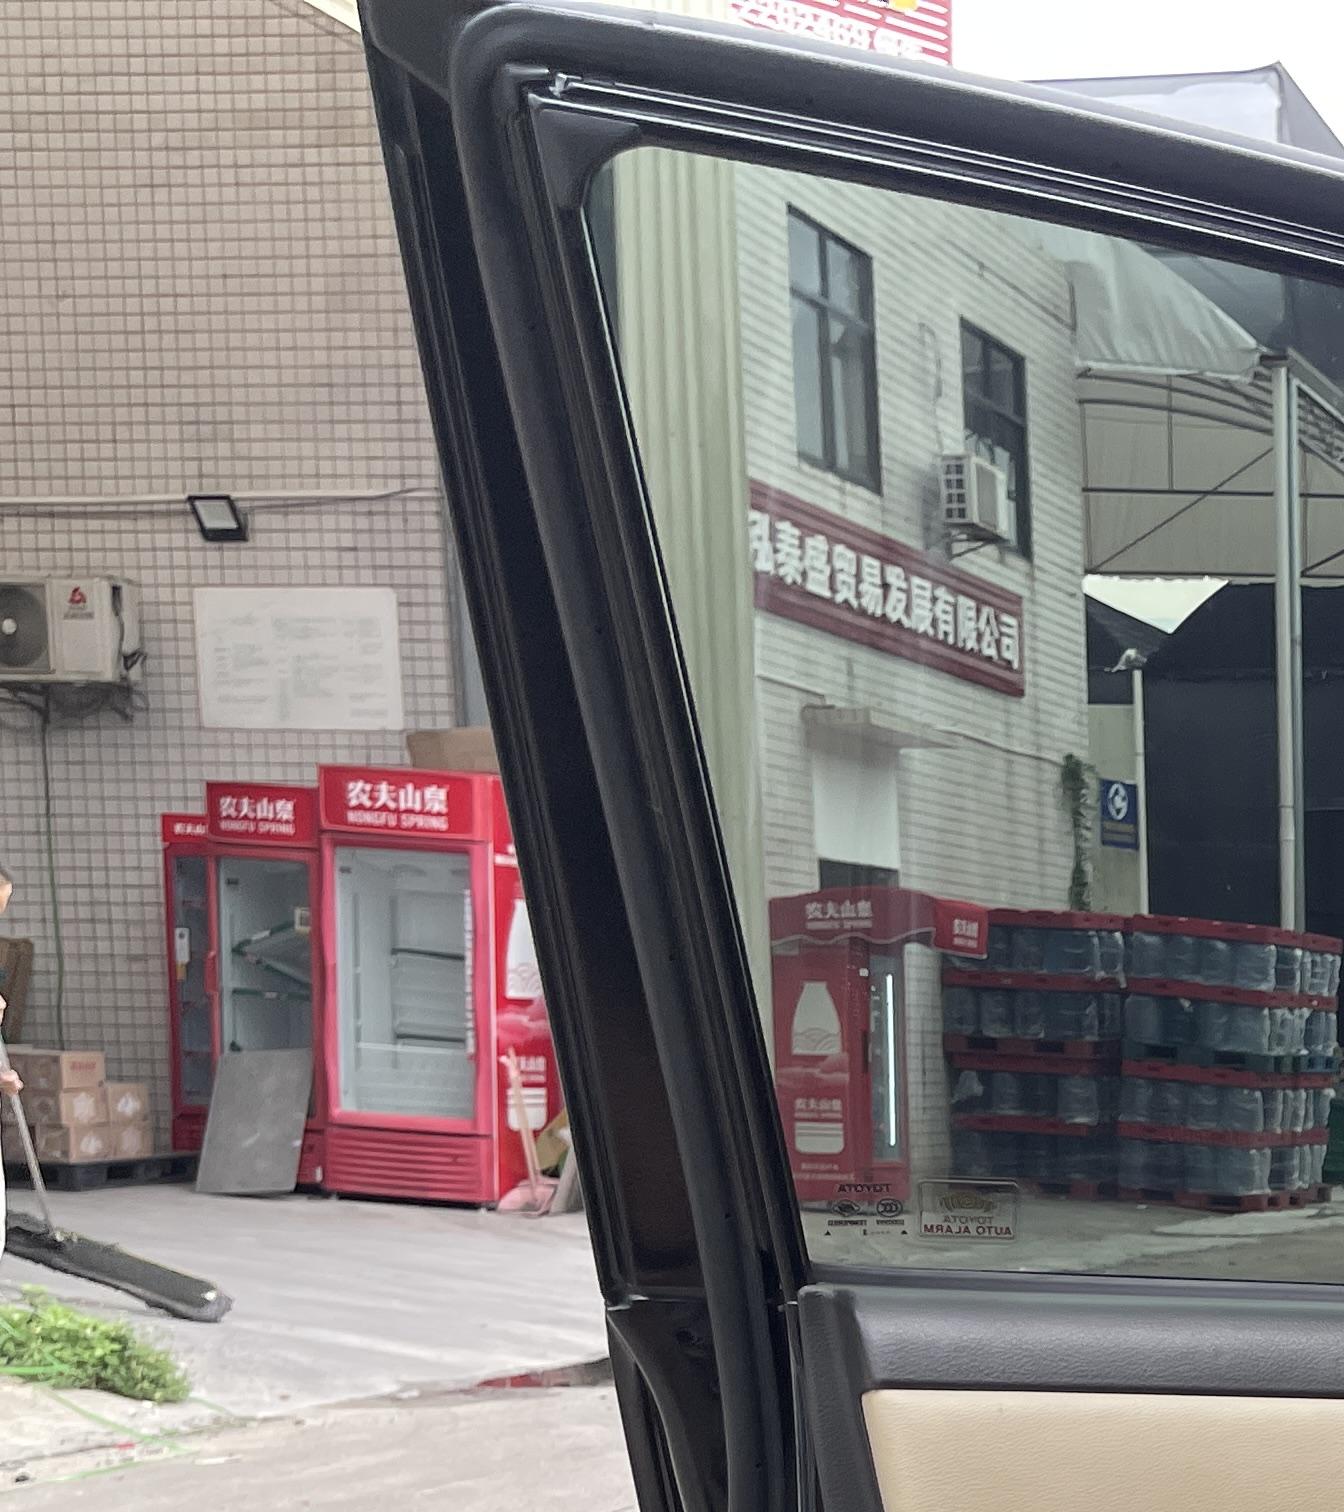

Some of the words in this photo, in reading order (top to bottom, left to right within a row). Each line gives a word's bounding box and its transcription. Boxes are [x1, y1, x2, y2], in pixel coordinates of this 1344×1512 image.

[219, 796, 295, 821] 农夫山泉
[345, 779, 448, 814] 农夫山泉
[402, 812, 449, 831] SPRING
